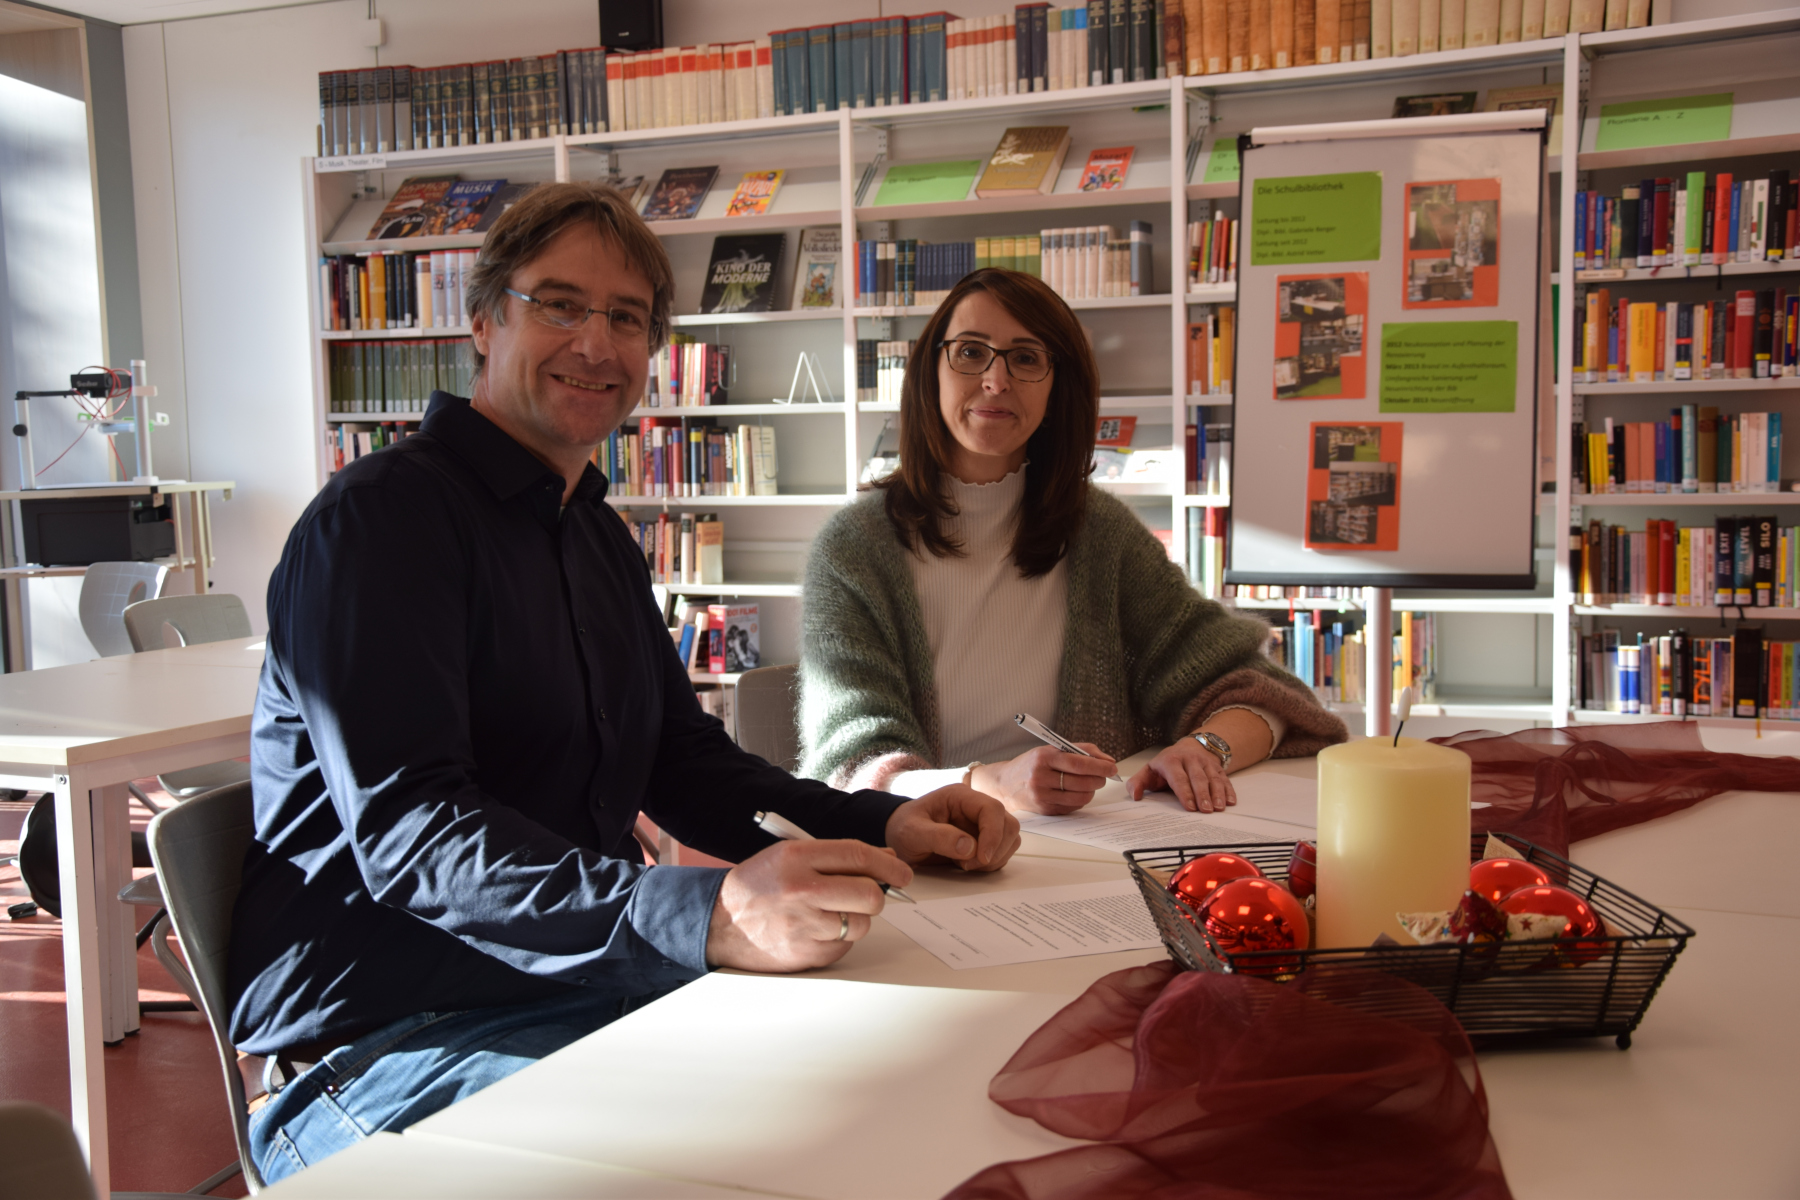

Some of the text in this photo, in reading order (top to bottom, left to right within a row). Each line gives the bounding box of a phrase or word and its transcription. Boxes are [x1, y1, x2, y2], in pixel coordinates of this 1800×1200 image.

[1607, 116, 1650, 125] Romane
[328, 160, 346, 168] Musik,
[452, 183, 494, 194] MUSIK
[1258, 182, 1344, 195] Die Schulbibliothek
[716, 262, 772, 273] KINO DER
[711, 272, 770, 284] MODERNE
[1740, 526, 1750, 554] LEVEL
[1760, 522, 1770, 548] SILO
[1720, 532, 1730, 554] EXIT
[740, 606, 758, 615] FILME
[1693, 650, 1711, 704] TYLL
